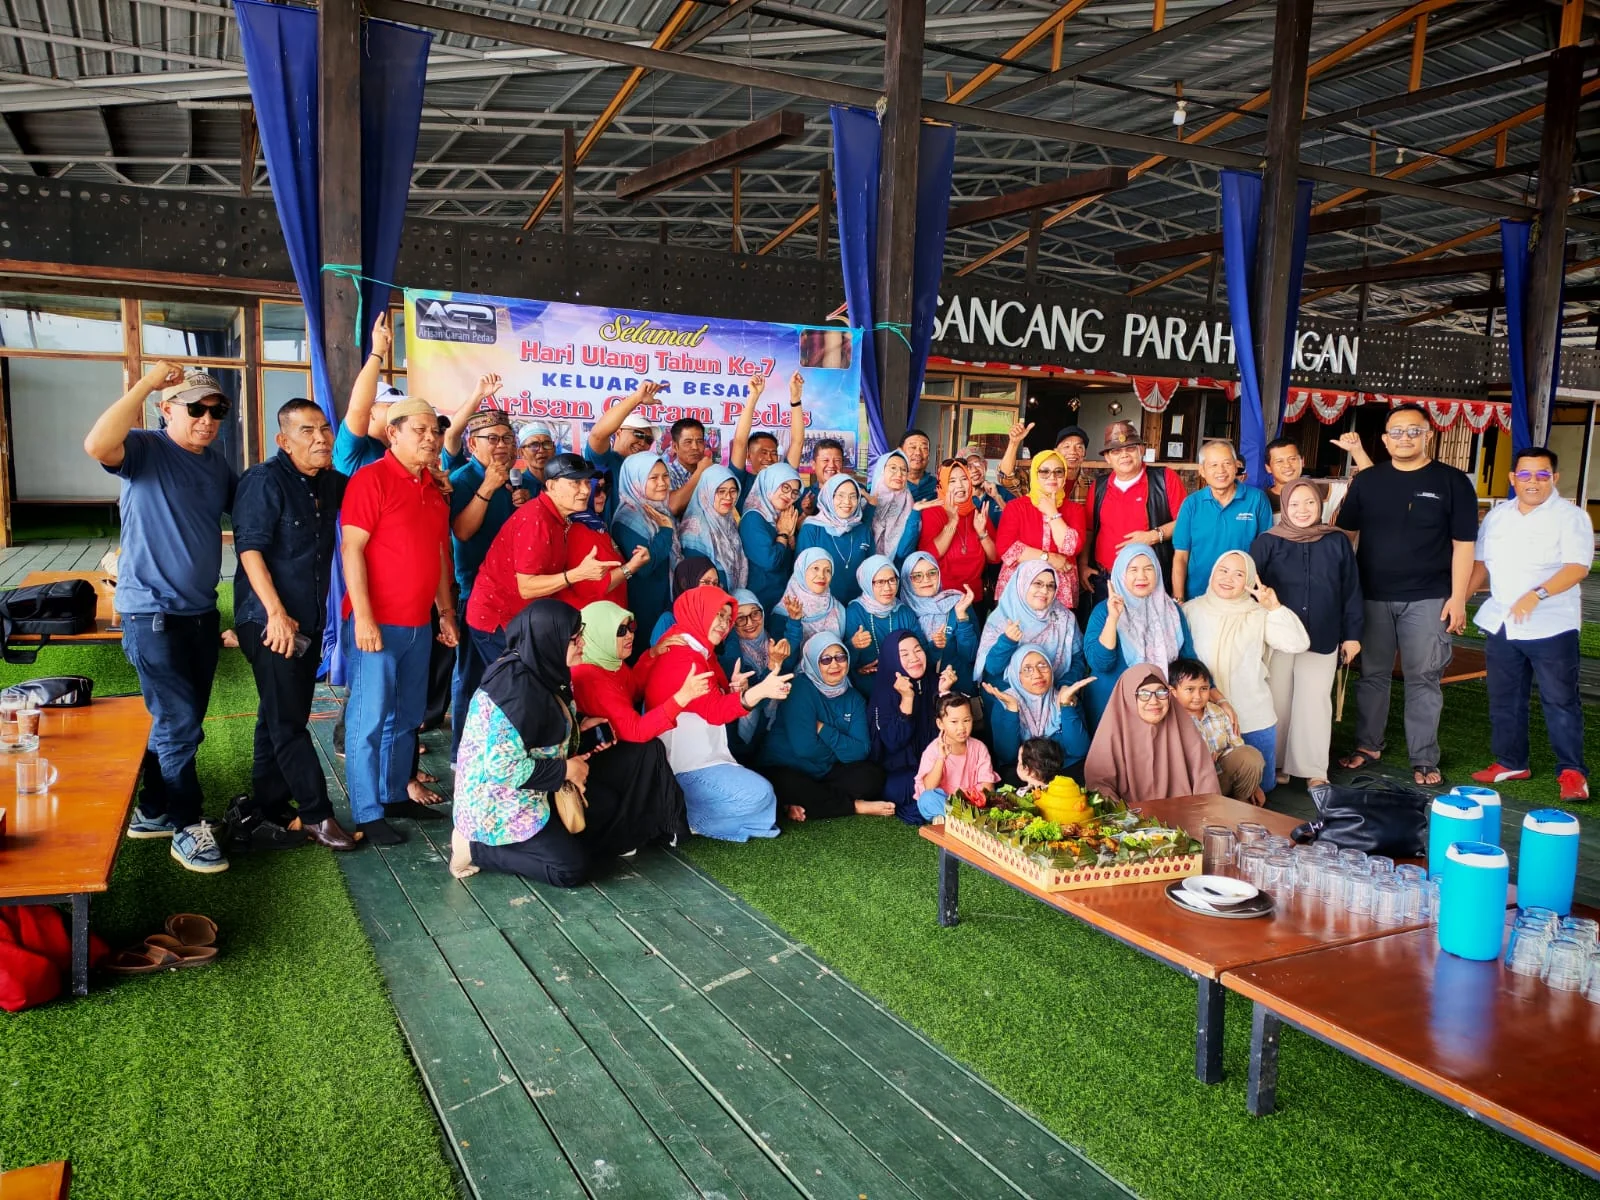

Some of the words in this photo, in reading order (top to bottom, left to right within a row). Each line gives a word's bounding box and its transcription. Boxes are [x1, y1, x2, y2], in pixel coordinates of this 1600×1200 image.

[418, 326, 444, 338] Arisan
[445, 329, 471, 341] Garam
[472, 331, 495, 342] Pedas
[599, 314, 710, 348] Selamat
[931, 294, 1106, 353] SANCANG
[520, 339, 575, 365] Hari
[580, 344, 649, 374] Ulang
[655, 351, 721, 374] Tahun
[728, 356, 776, 377] Ke-7
[541, 372, 672, 394] KELUARA
